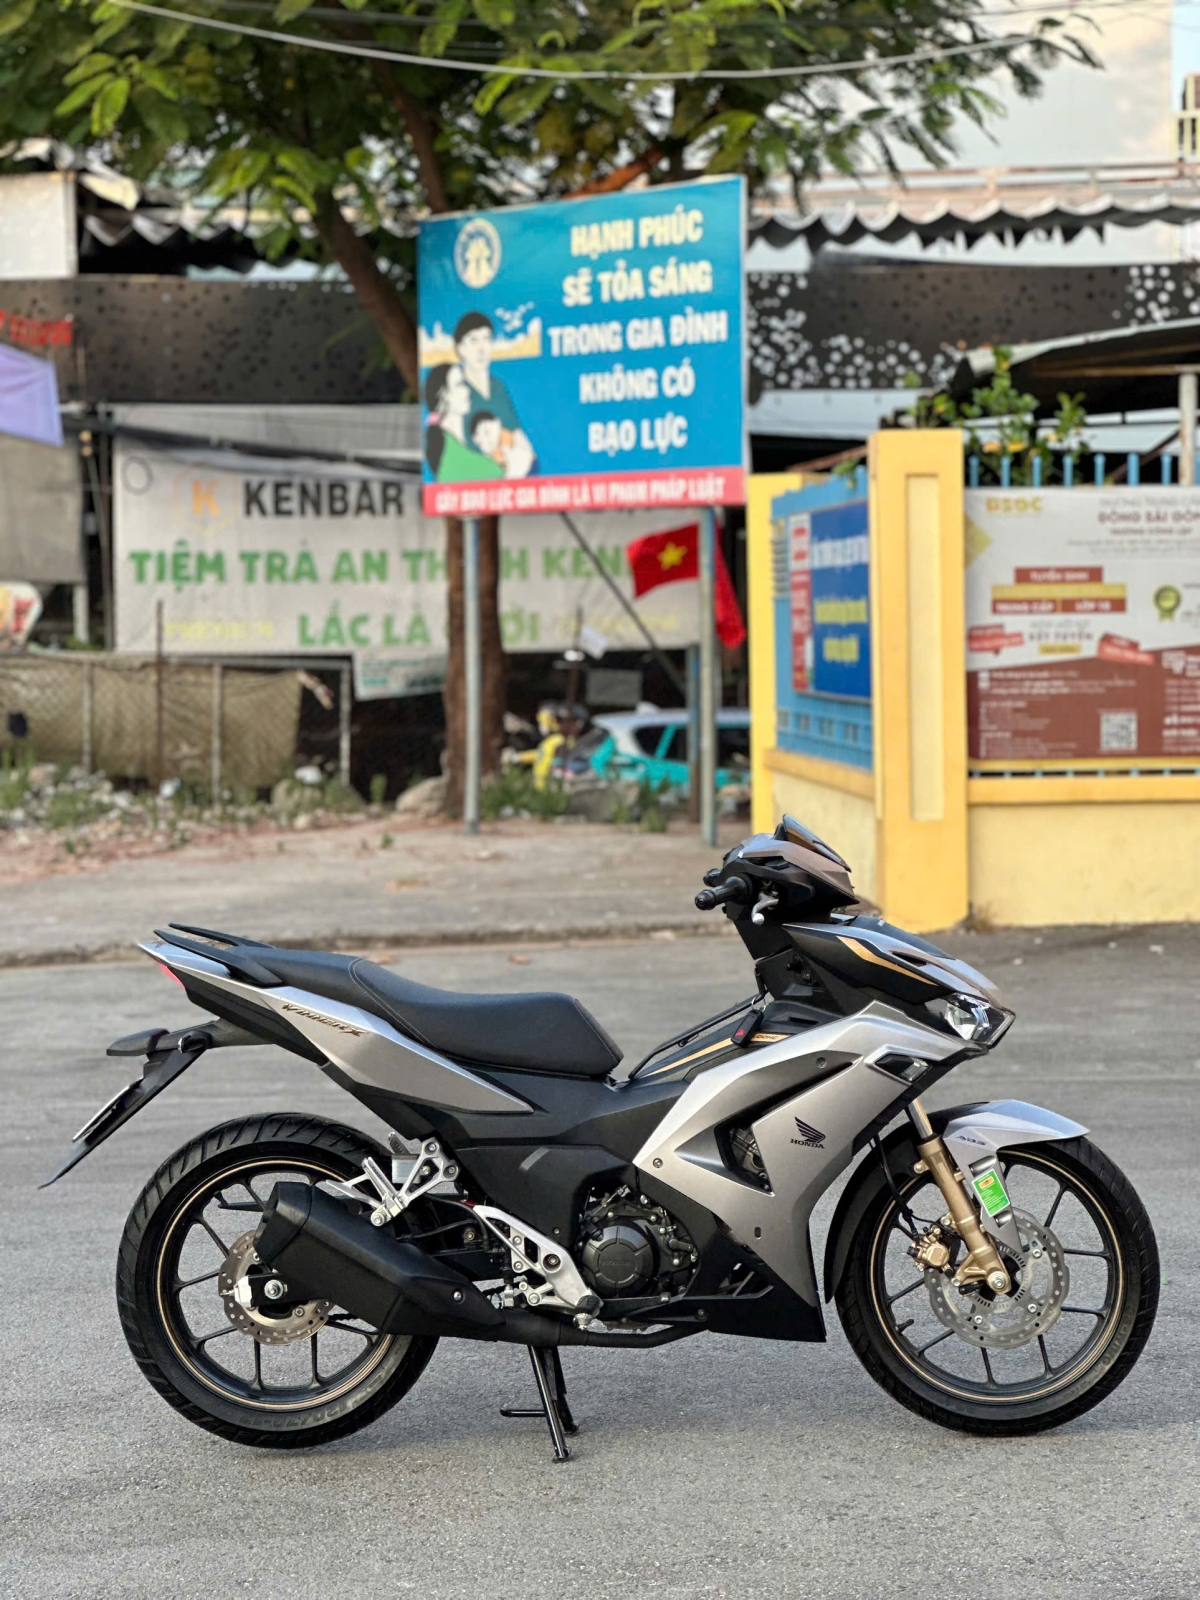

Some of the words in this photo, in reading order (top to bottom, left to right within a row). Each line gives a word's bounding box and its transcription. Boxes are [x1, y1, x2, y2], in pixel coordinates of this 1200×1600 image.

[570, 219, 634, 260] HẠNH
[638, 203, 703, 248] PHÚC
[562, 266, 593, 307] SẼ
[597, 259, 644, 302] TỎA
[648, 256, 713, 298] SÁNG
[548, 321, 623, 357] TRONG
[626, 317, 666, 350] GIA
[669, 305, 729, 346] ĐÌNH
[579, 363, 658, 404] KHÔNG
[661, 357, 695, 397] CÓ
[588, 420, 636, 457] BẠO
[641, 412, 688, 454] LỰC
[191, 479, 221, 517] K
[244, 480, 404, 518] KENBAR
[128, 538, 226, 594] TIỆM
[331, 548, 389, 584] AN
[790, 1138, 826, 1150] HONDA
